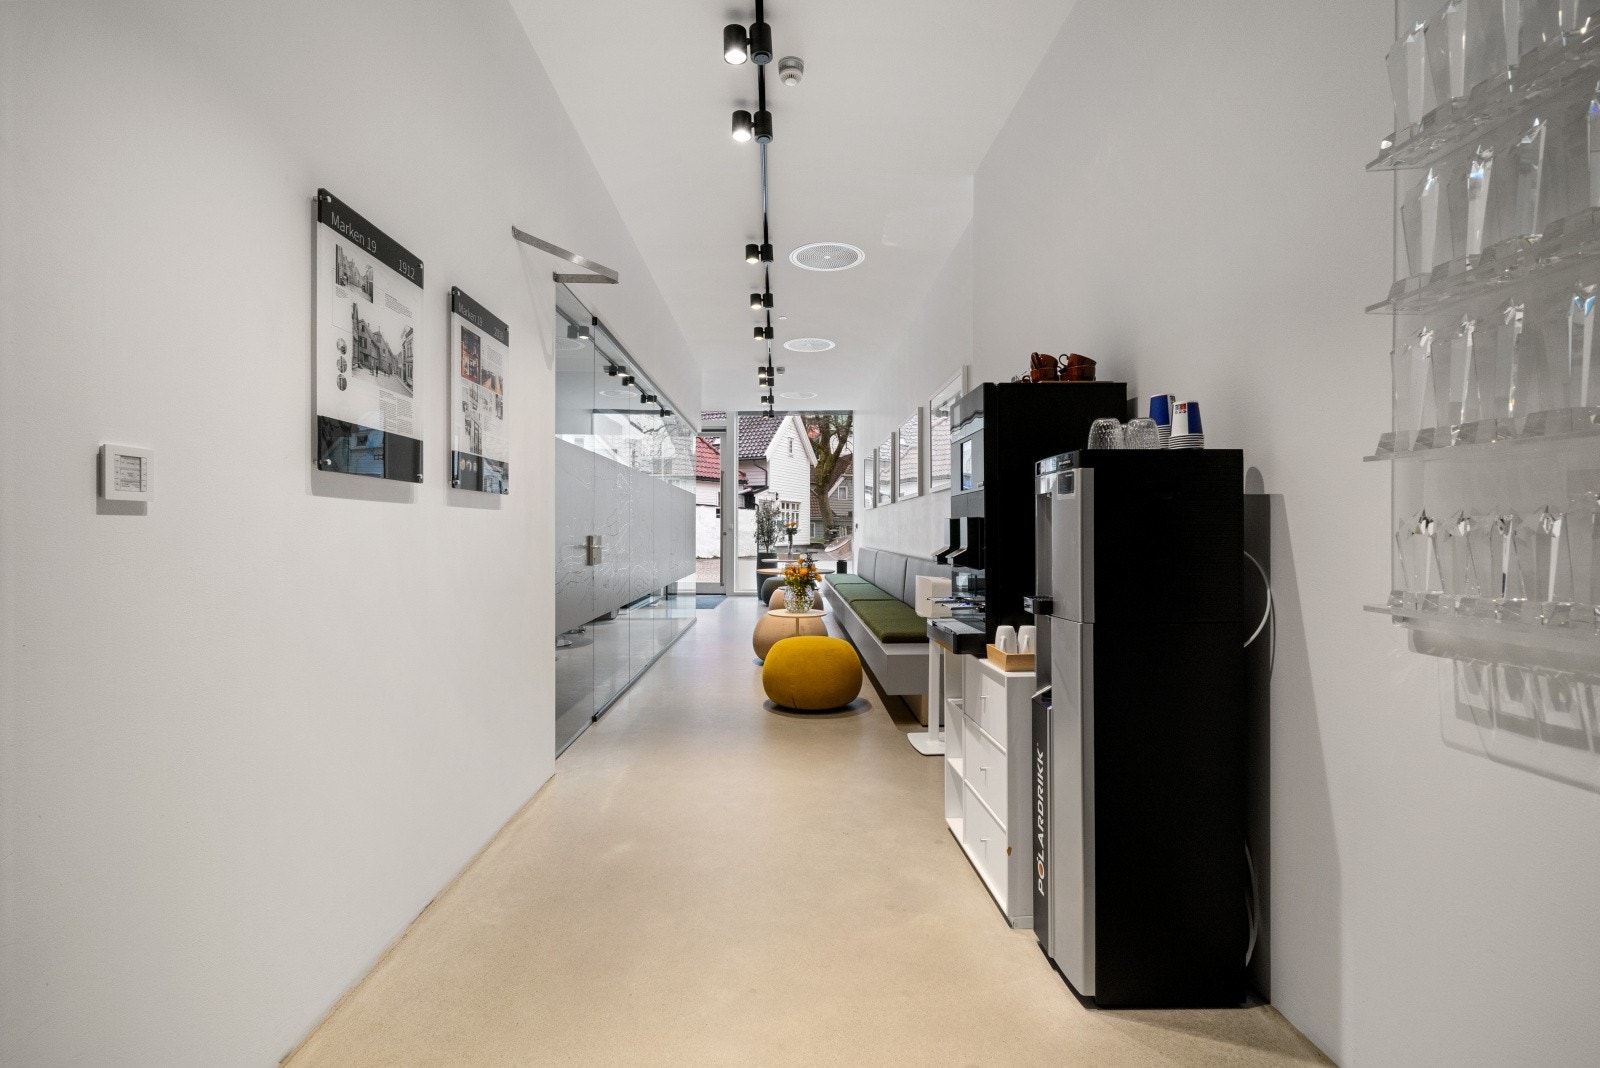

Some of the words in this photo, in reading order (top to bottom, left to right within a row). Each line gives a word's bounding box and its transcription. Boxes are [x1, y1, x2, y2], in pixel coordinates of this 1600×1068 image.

[331, 211, 365, 246] Marken
[367, 237, 377, 253] 19
[398, 259, 415, 280] 1912
[1036, 747, 1045, 896] POLARDRIKK
